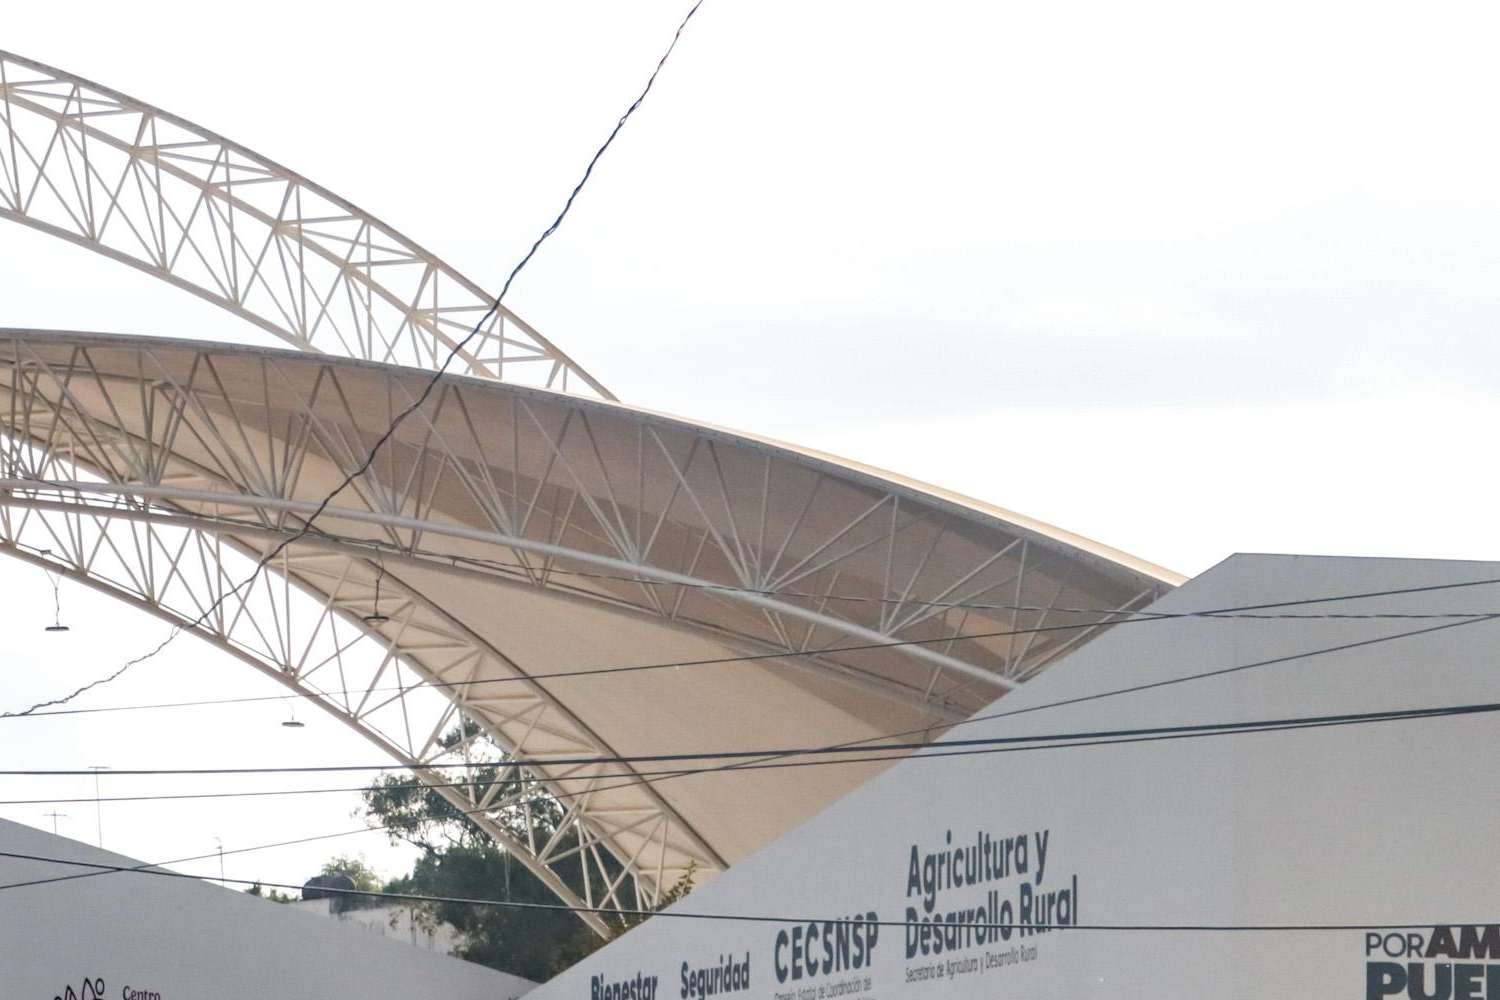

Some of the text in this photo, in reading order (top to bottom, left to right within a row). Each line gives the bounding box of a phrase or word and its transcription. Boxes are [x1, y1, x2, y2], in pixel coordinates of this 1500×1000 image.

[907, 829, 1050, 913] Agricultura y
[774, 911, 879, 984] CECSNSP
[905, 874, 1078, 959] Desarrollo Rural
[1365, 932, 1425, 958] POR
[946, 955, 978, 980] Agricultura
[985, 945, 1019, 970] Desarrollo
[1020, 944, 1038, 963] Rural
